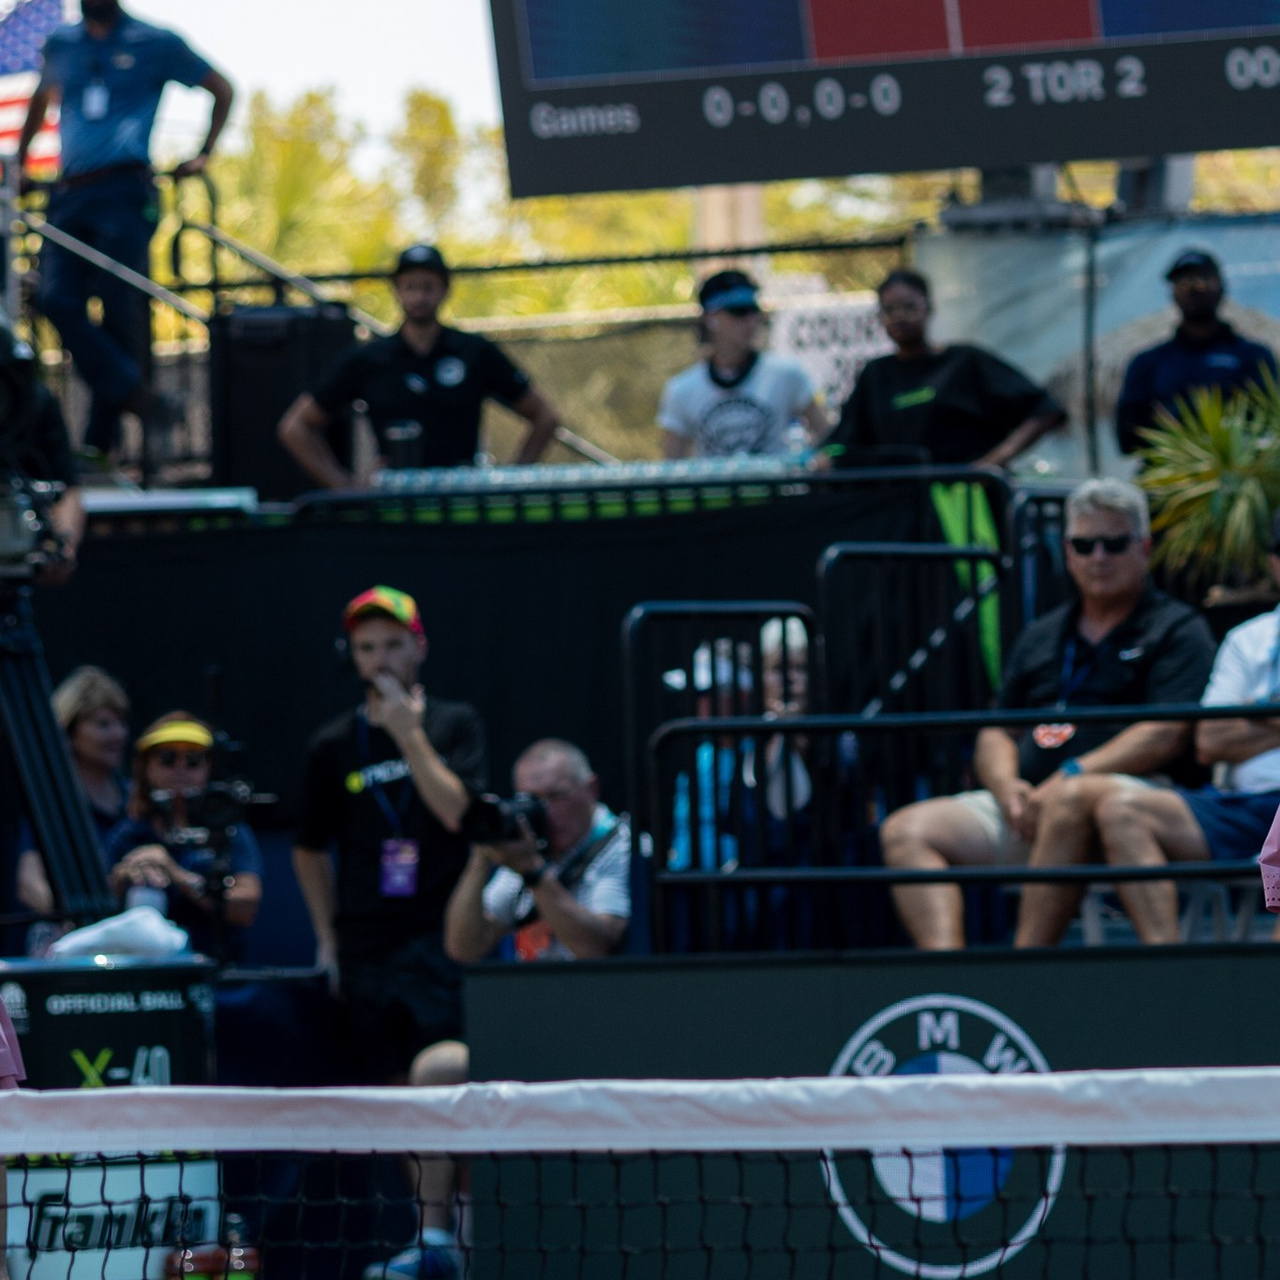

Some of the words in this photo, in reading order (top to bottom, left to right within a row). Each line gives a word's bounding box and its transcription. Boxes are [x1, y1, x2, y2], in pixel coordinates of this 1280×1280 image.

[983, 65, 1014, 106] 2
[1021, 60, 1104, 104] TOR
[1115, 56, 1146, 98] 2
[529, 102, 641, 138] Games
[46, 993, 138, 1015] OFFICIAL
[852, 1010, 1031, 1077] BMW
